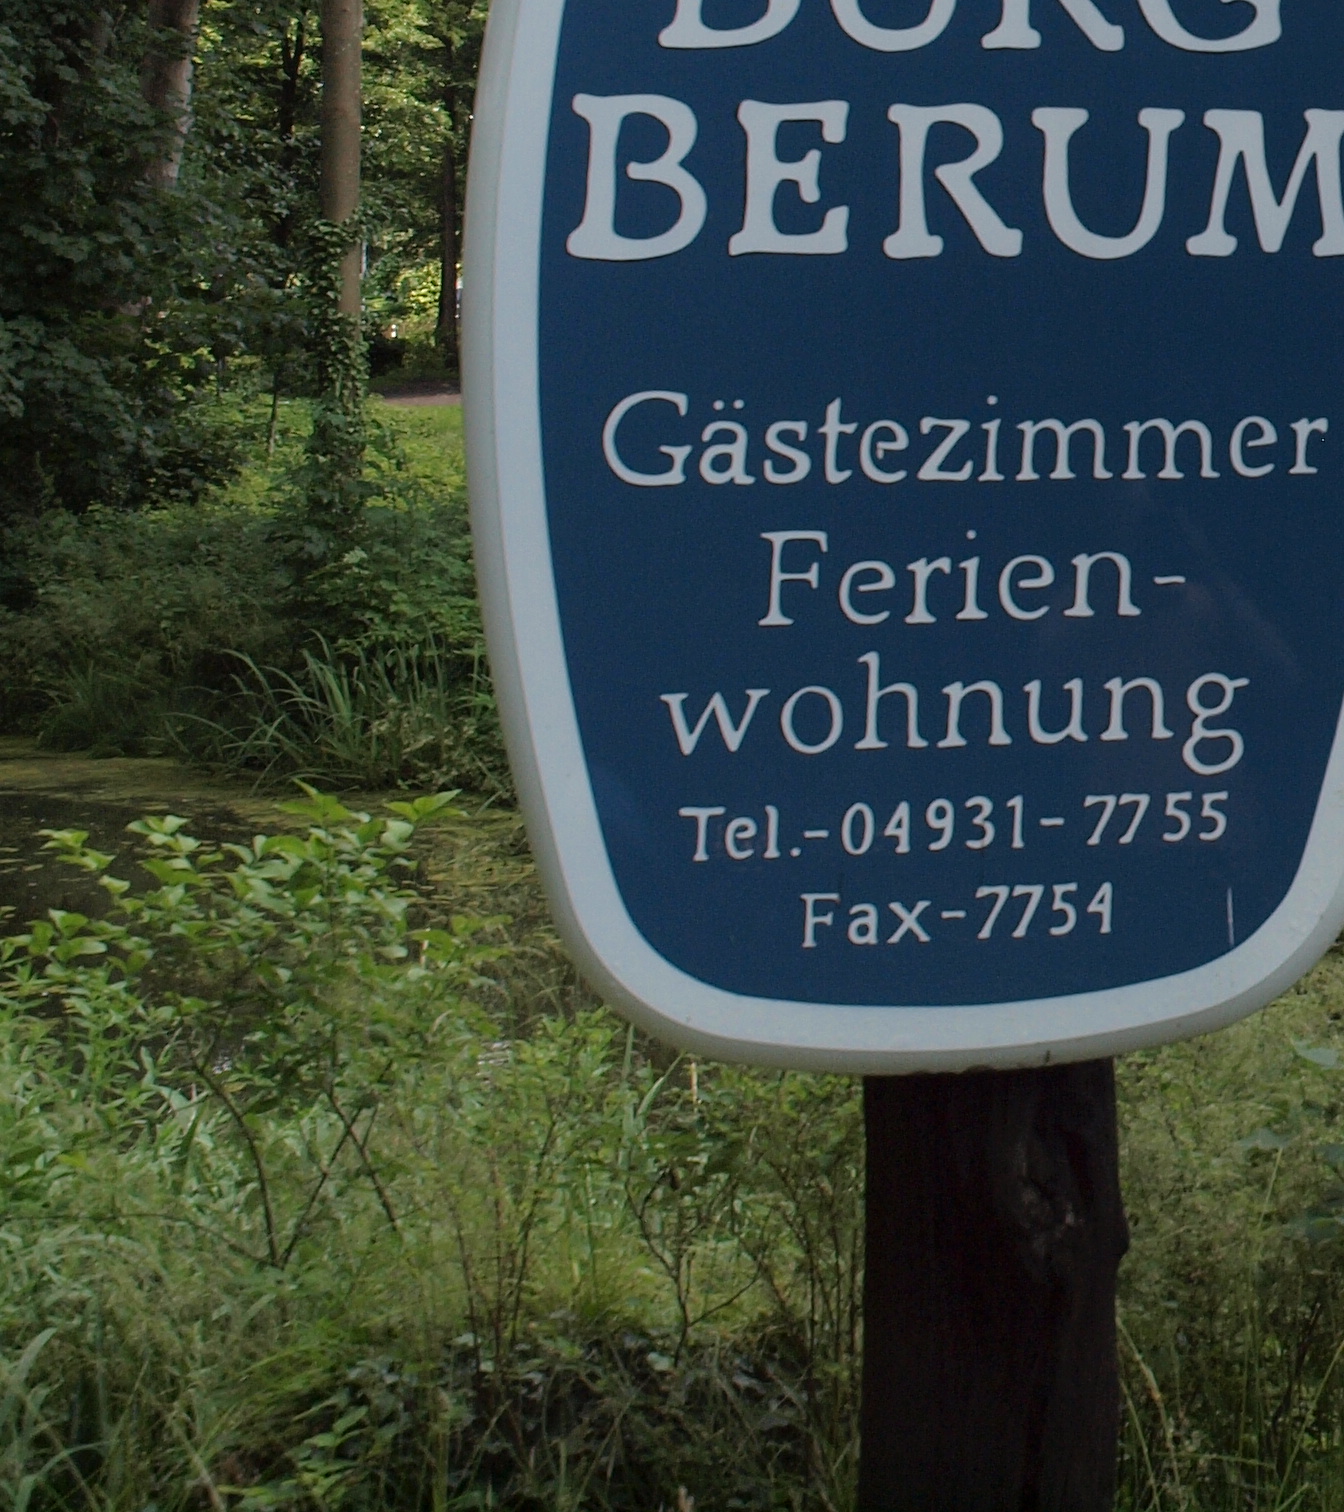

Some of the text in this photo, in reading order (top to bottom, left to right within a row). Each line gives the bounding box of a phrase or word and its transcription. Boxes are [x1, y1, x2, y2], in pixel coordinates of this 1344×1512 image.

[601, 390, 1329, 487] Gästezimmer
[757, 529, 1187, 627] Ferien-
[660, 652, 1250, 776] wohnung
